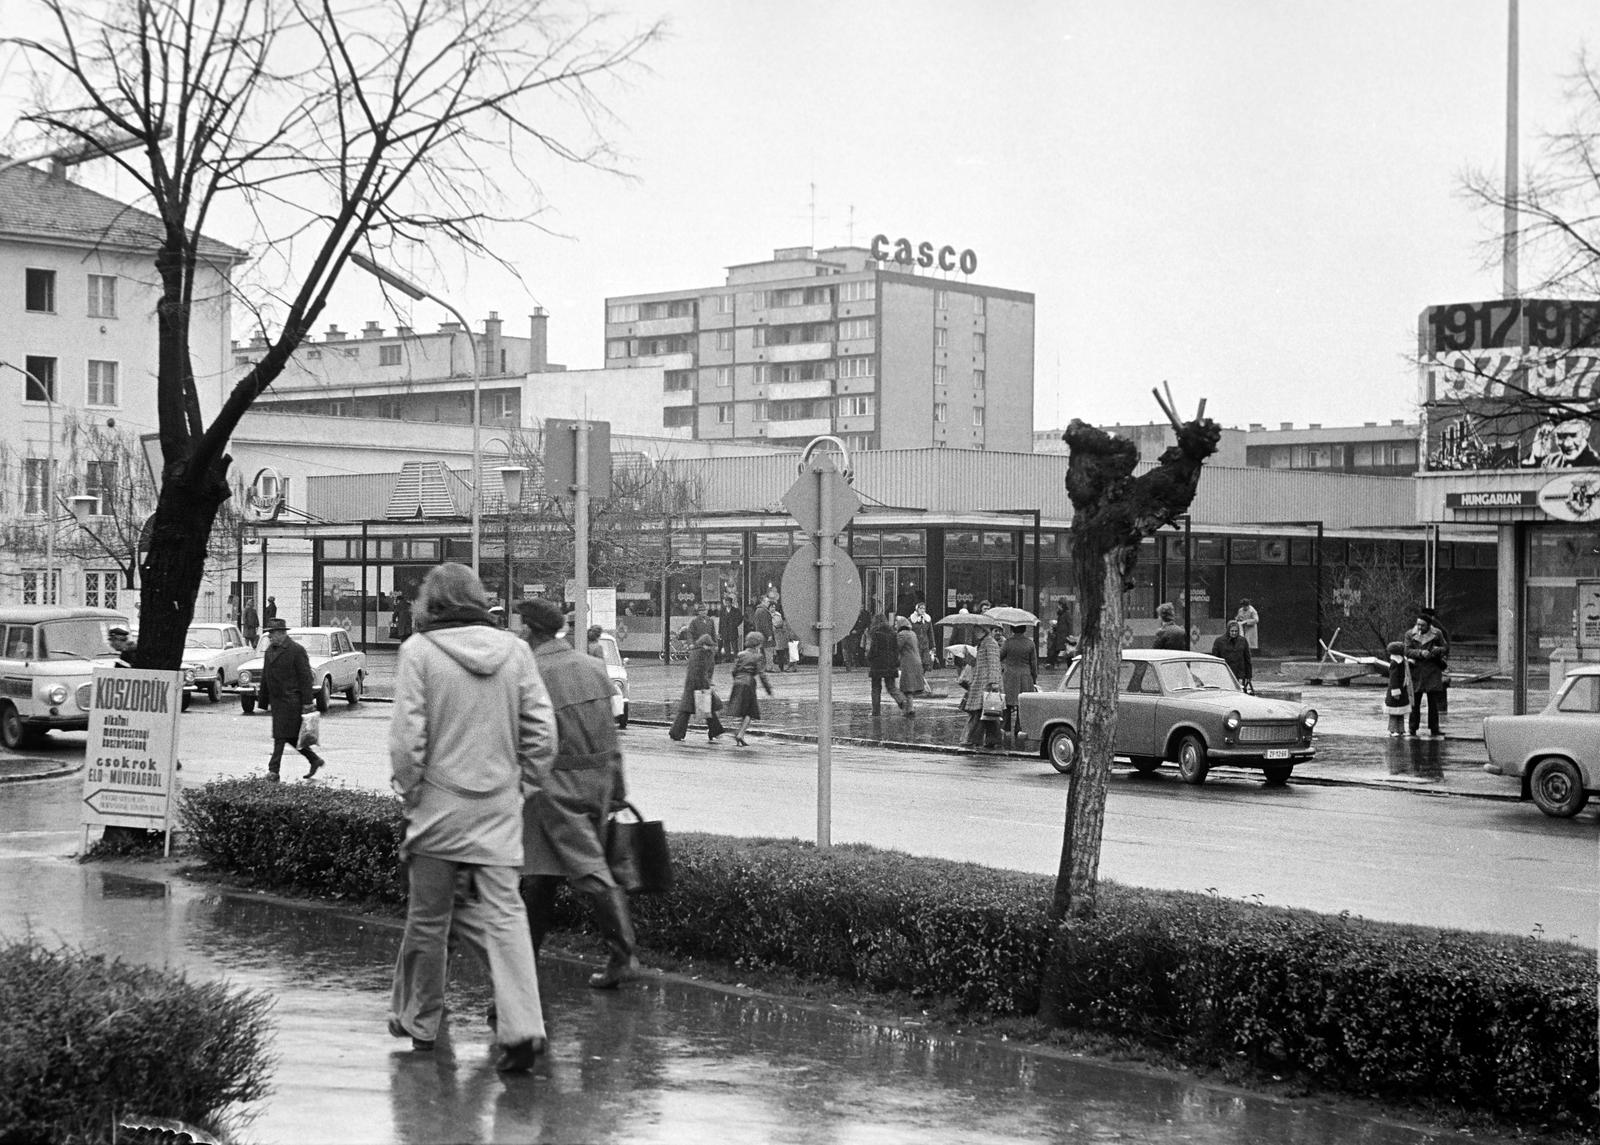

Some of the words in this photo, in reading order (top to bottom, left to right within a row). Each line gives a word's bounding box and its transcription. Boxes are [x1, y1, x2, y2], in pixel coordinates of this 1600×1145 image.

[871, 234, 977, 275] casco
[1429, 300, 1522, 351] 1917
[1420, 347, 1522, 400] 1977
[1461, 493, 1521, 505] HUNGARIAN
[96, 756, 156, 771] csokrok
